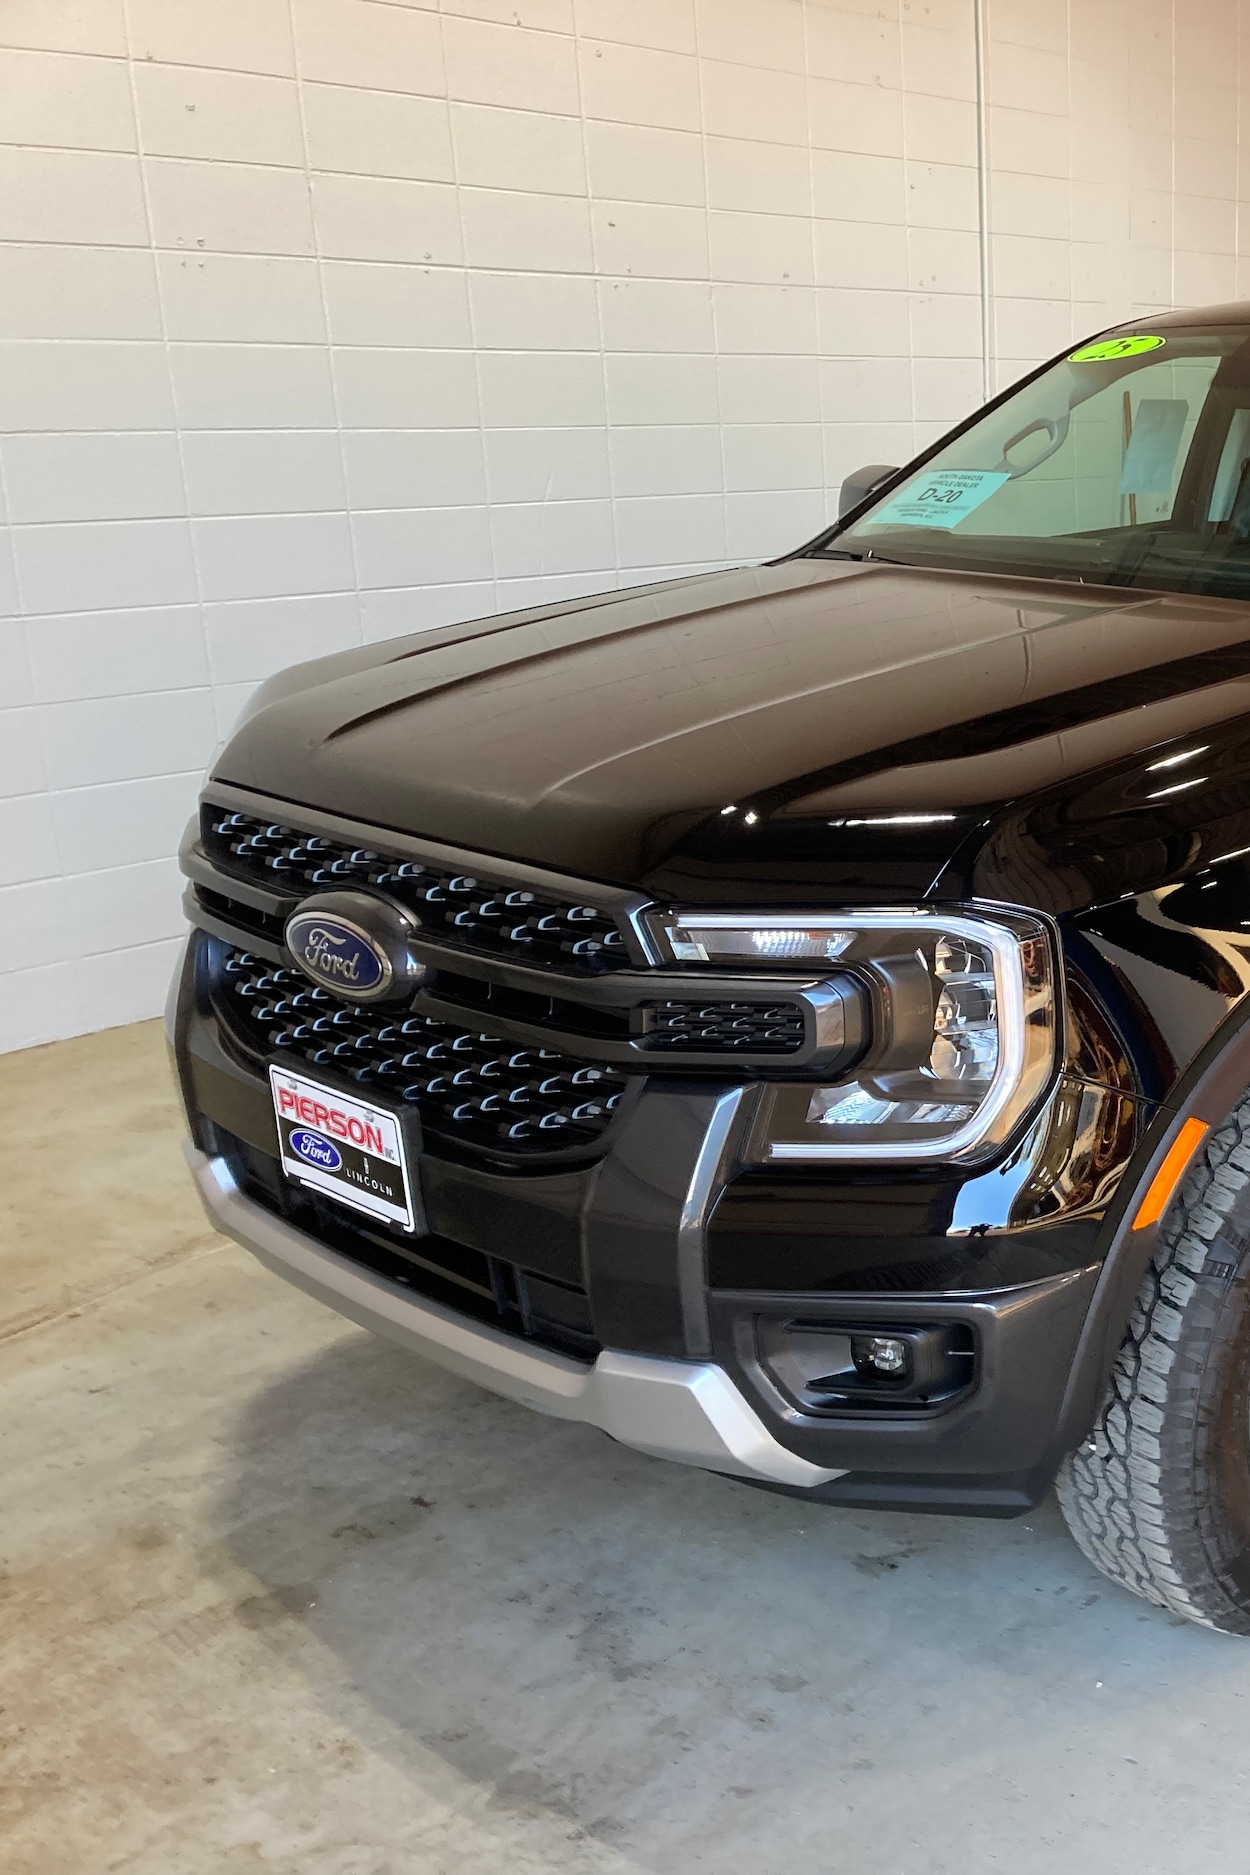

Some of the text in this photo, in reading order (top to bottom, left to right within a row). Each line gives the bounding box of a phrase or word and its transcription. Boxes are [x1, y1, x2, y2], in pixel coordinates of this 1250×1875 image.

[917, 488, 963, 503] D-20
[304, 928, 360, 980] Ford
[278, 1087, 384, 1156] PIERSON
[301, 1134, 332, 1164] Ford
[345, 1169, 393, 1197] LINCOLN
